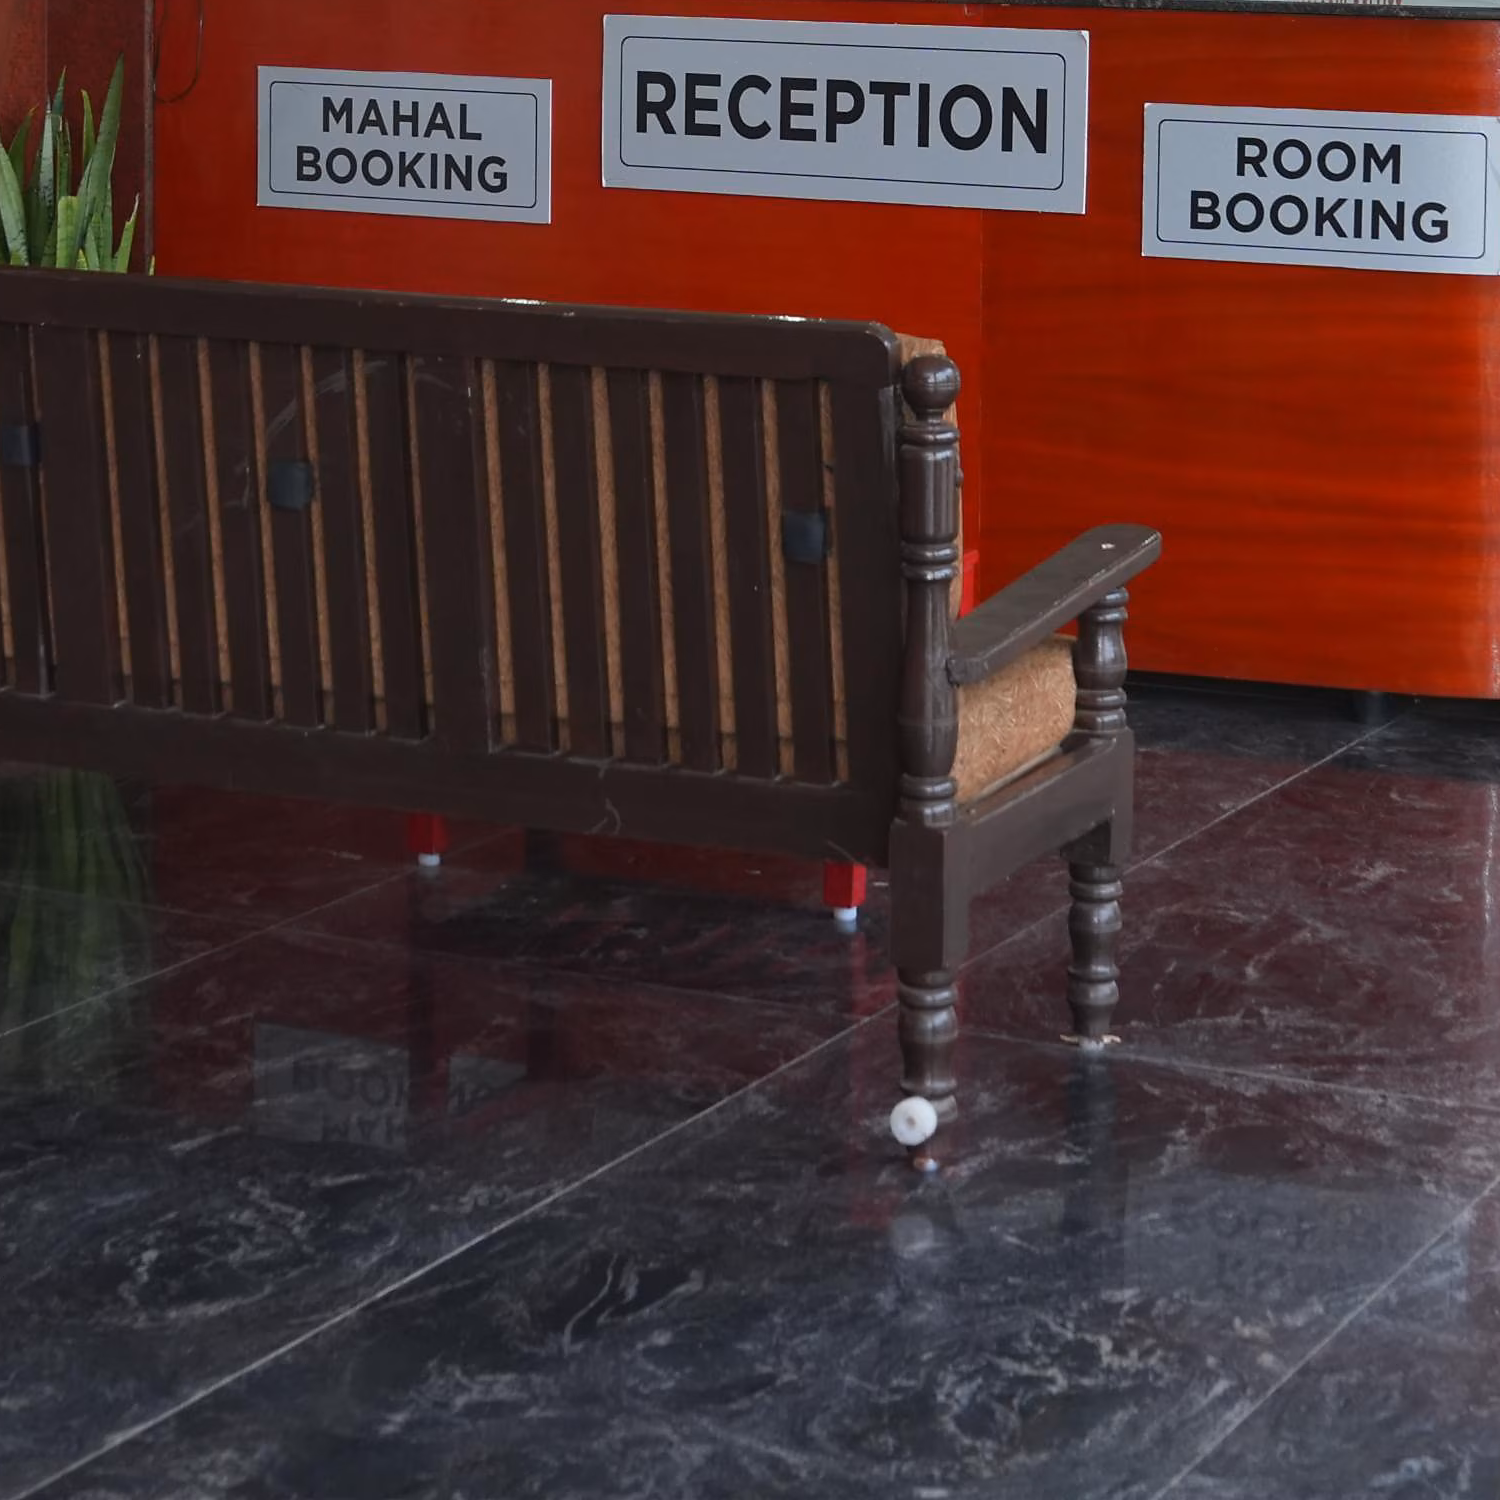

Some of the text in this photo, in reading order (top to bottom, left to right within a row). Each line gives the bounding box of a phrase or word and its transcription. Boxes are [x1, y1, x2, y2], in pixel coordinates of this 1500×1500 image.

[321, 97, 483, 141] MAHAL
[636, 70, 1049, 155] RECEPTION
[295, 146, 509, 194] BOOKING
[1236, 137, 1402, 185] ROOM
[1189, 190, 1450, 244] BOOKING
